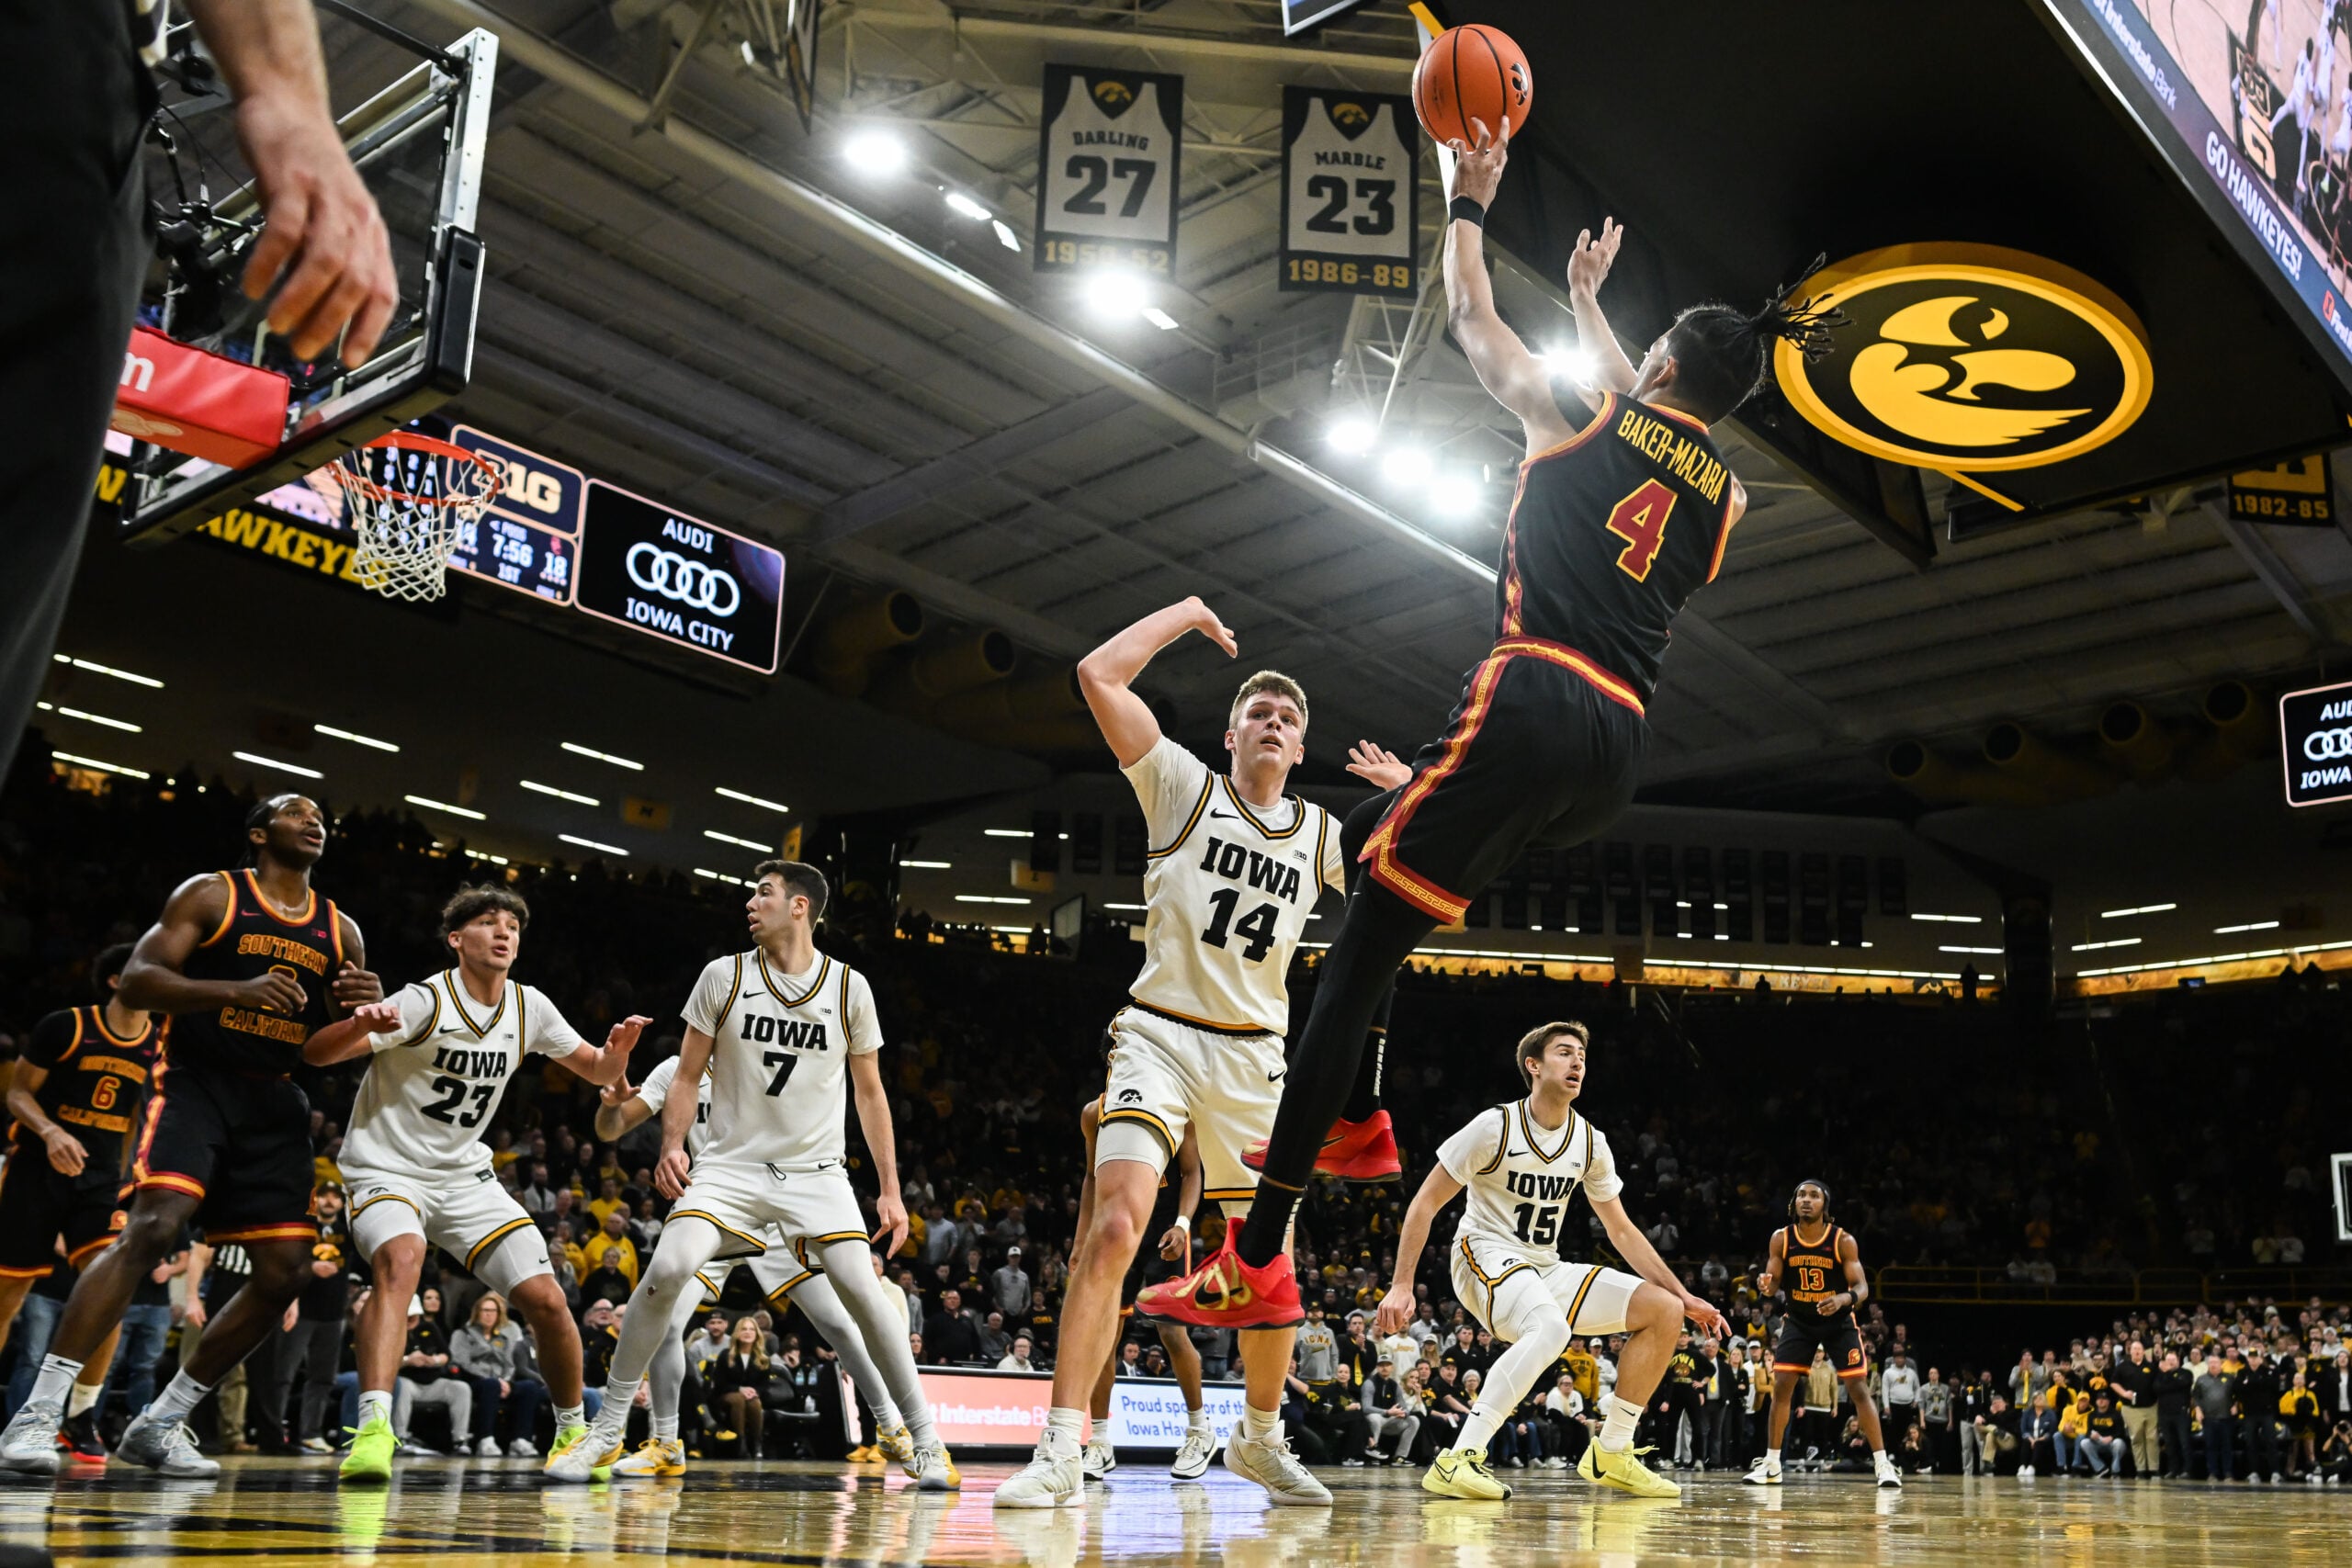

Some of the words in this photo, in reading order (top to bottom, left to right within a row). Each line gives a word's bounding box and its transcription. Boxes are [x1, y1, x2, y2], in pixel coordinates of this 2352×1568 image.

[1072, 130, 1149, 152] DARLING
[1314, 151, 1385, 171] MARBLE
[1063, 154, 1156, 218] 27
[1306, 175, 1396, 236] 23
[2206, 130, 2228, 179] GO
[2226, 158, 2302, 281] HAWKEYES!
[1288, 258, 1409, 289] 1986-89
[1617, 410, 1728, 505] BAKER-MAZARA
[2234, 494, 2329, 519] 1982-85
[662, 518, 714, 554] AUDI
[1605, 478, 1679, 583] 4
[492, 534, 534, 568] 7:56
[545, 551, 568, 580] 18
[497, 562, 522, 584] 1ST
[625, 597, 685, 637] IOWA
[687, 620, 735, 652] CITY
[2300, 765, 2352, 790] IOWA
[1199, 836, 1301, 905] IOWA
[1200, 887, 1280, 963] 14
[237, 933, 329, 976] SOUTHERN
[741, 1013, 829, 1051] IOWA
[432, 1046, 507, 1078] IOWA
[763, 1051, 797, 1097] 7
[90, 1075, 123, 1111] 6
[421, 1075, 496, 1128] 23
[1506, 1169, 1576, 1201] IOWA
[1513, 1202, 1559, 1245] 15
[1799, 1268, 1825, 1291] 13
[940, 1403, 1031, 1426] Interstate
[1121, 1395, 1161, 1413] Proud
[1165, 1401, 1215, 1417] spoor
[1219, 1400, 1230, 1415] of
[1234, 1401, 1244, 1416] th
[1126, 1420, 1159, 1436] Iowa
